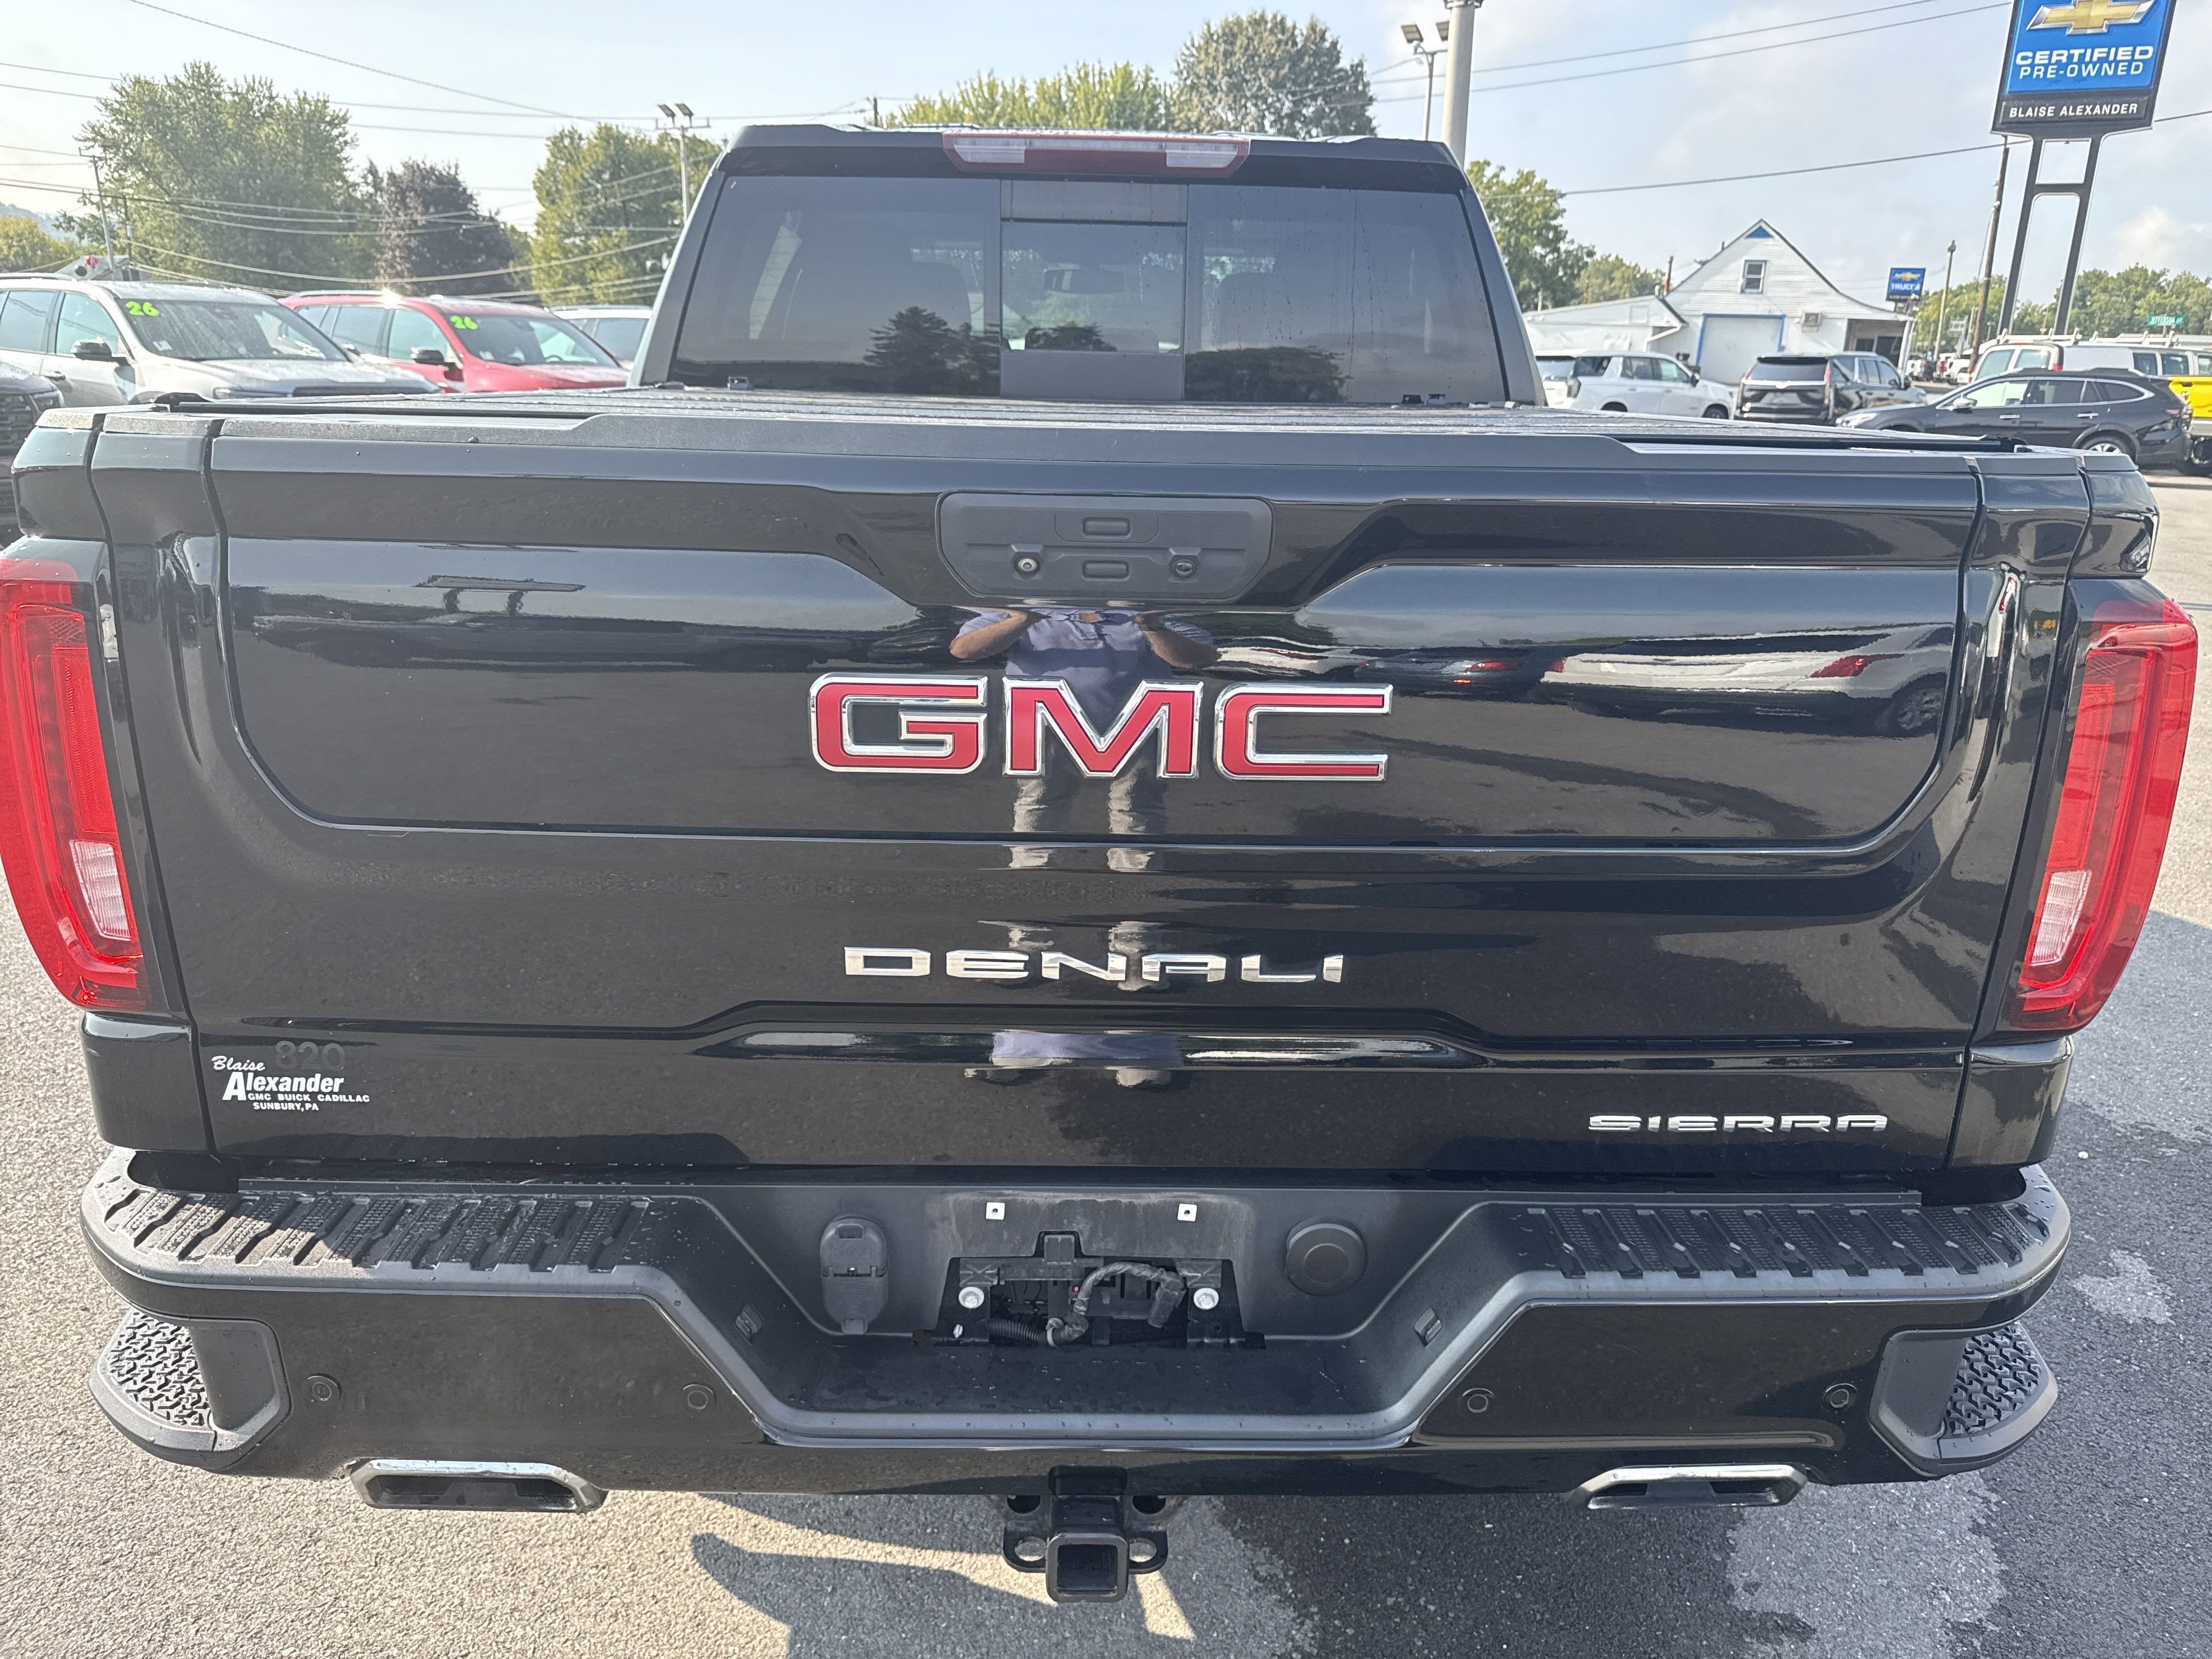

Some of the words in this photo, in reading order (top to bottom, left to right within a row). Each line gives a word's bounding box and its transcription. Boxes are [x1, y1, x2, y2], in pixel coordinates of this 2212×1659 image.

[2016, 46, 2154, 65] CERTIFIED
[2019, 61, 2143, 79] PRE-OWNED
[2009, 106, 2056, 118] BLAISE
[2059, 103, 2138, 117] ALEXANDER
[125, 301, 159, 317] 26
[450, 315, 478, 330] 26
[2149, 316, 2175, 325] JEFFERSON
[809, 672, 1393, 781] GMC
[844, 946, 1344, 983] DENALI
[211, 1056, 266, 1071] Blaise
[275, 1040, 346, 1071] 820
[222, 1071, 345, 1101] Alexander
[317, 1094, 370, 1102] CADILLAC
[1589, 1115, 1888, 1132] SIERRA
